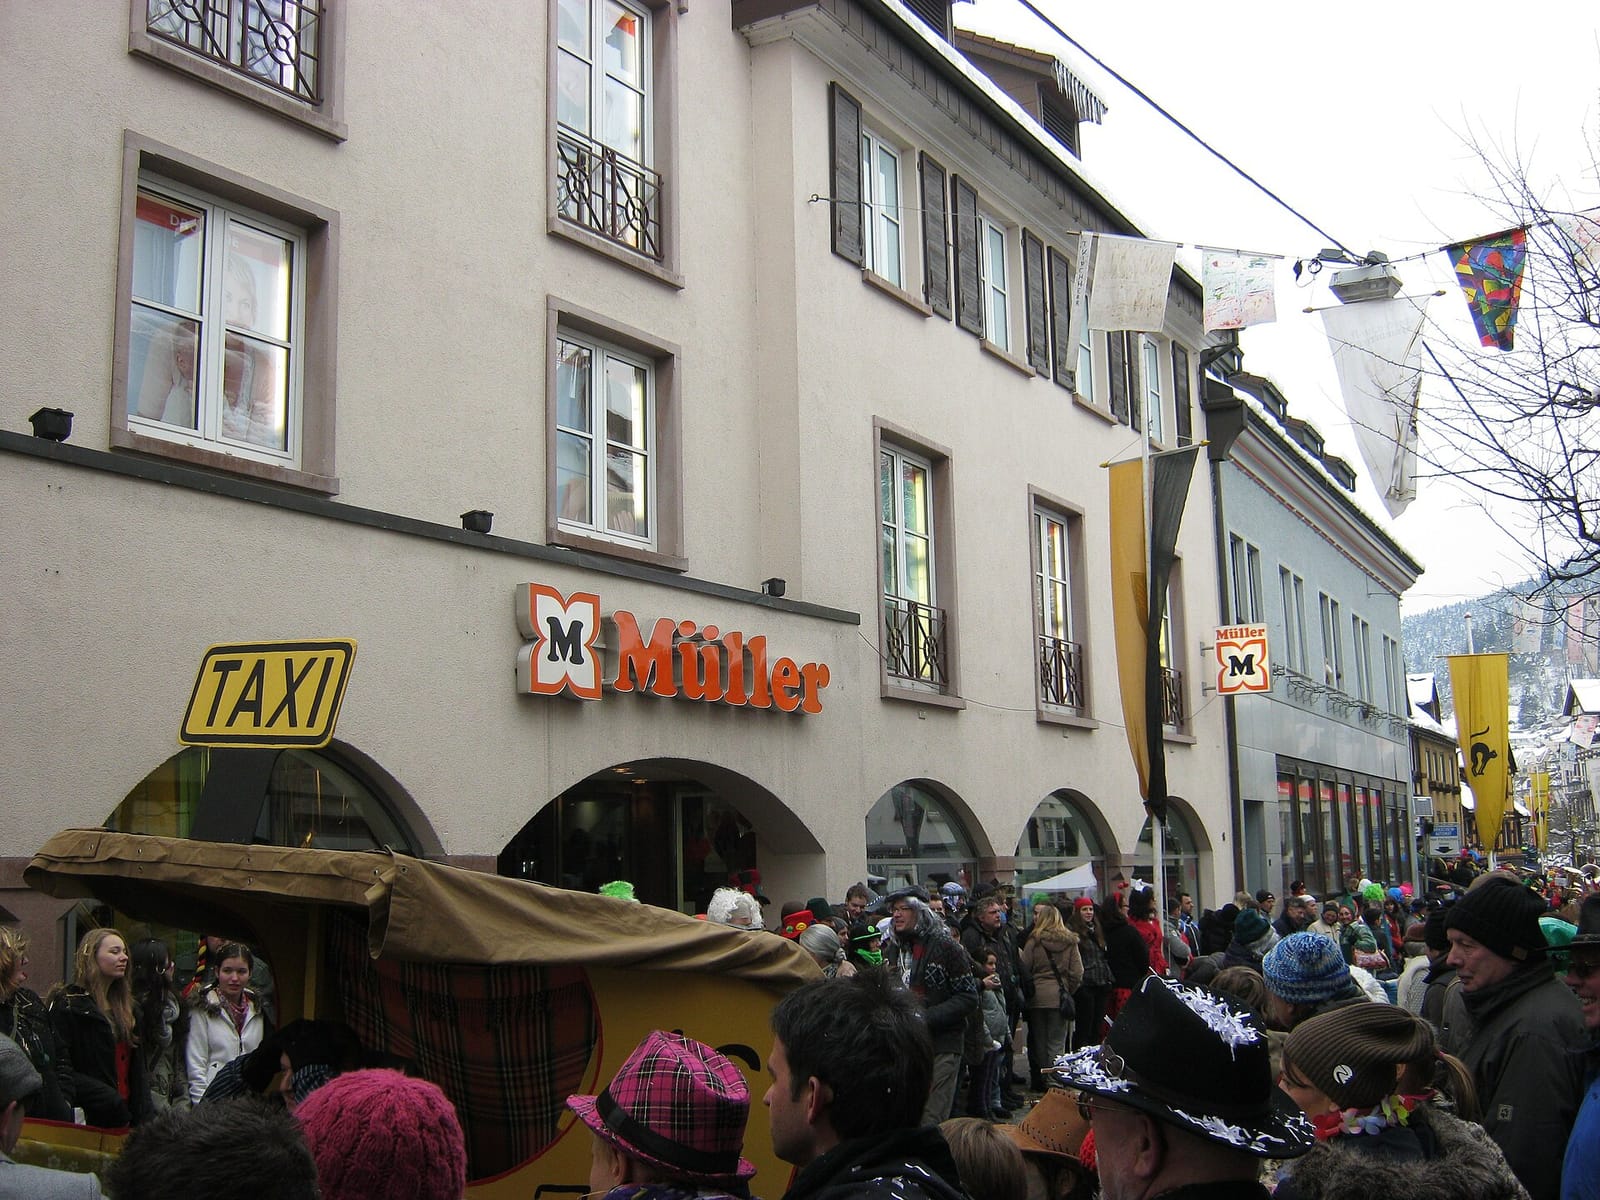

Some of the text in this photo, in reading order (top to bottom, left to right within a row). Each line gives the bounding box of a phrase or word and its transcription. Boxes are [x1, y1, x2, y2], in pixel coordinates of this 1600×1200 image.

[546, 616, 585, 665] M
[1215, 627, 1265, 640] Müller
[612, 609, 831, 714] Müller
[1228, 653, 1255, 677] M
[205, 656, 335, 729] TAXI
